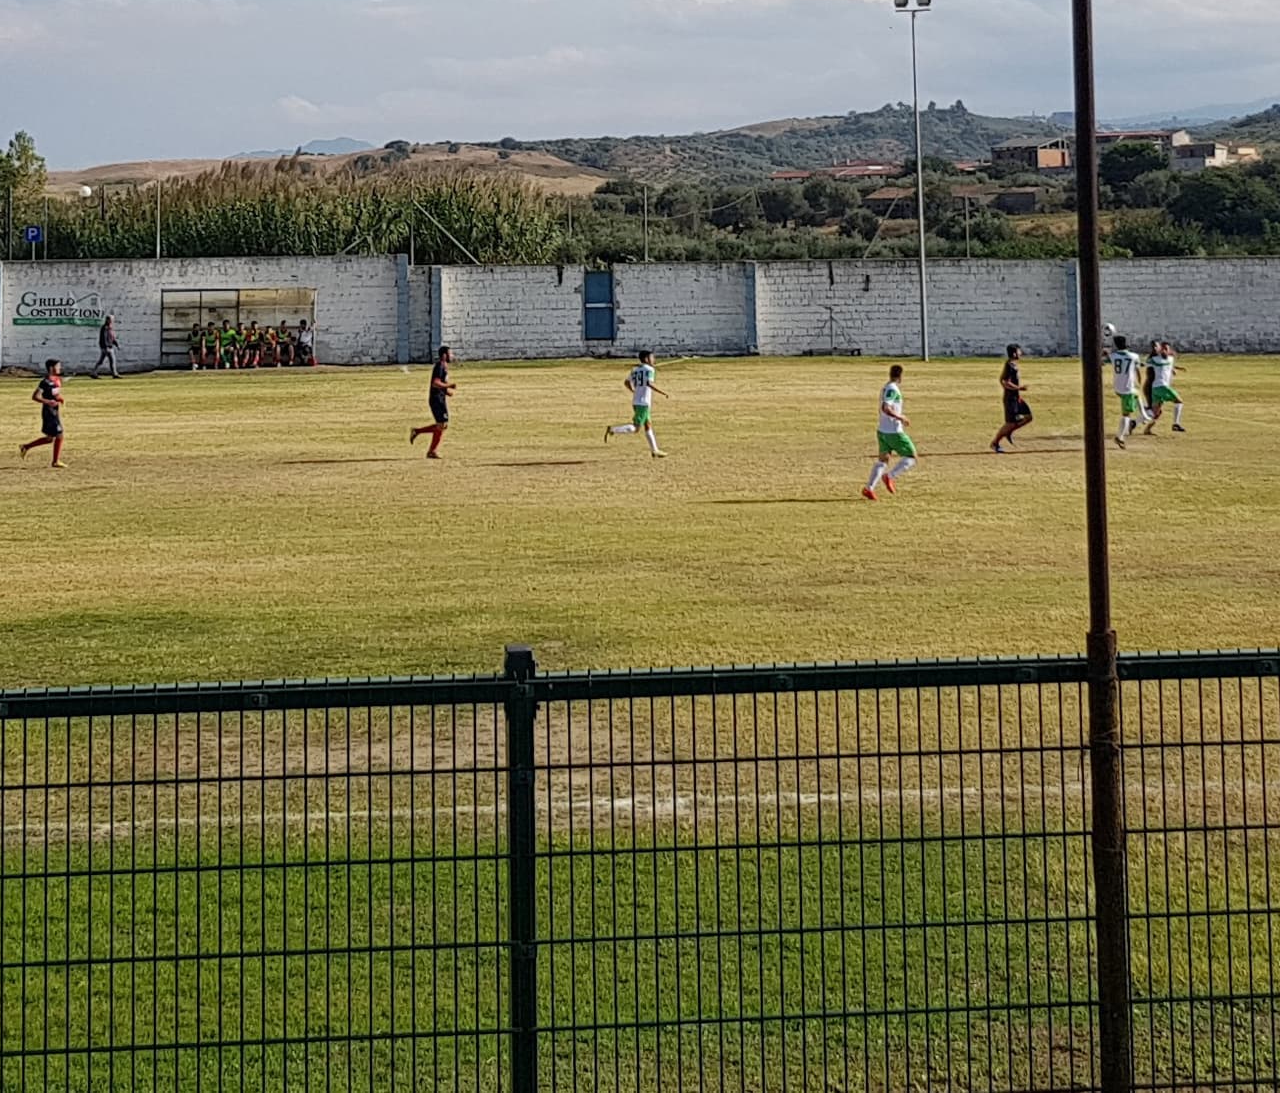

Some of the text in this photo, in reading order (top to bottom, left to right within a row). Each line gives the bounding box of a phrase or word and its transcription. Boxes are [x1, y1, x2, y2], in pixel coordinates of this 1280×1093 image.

[22, 291, 75, 307] GRILLO
[16, 303, 105, 318] COSTRUZIONI
[1114, 358, 1132, 375] 87
